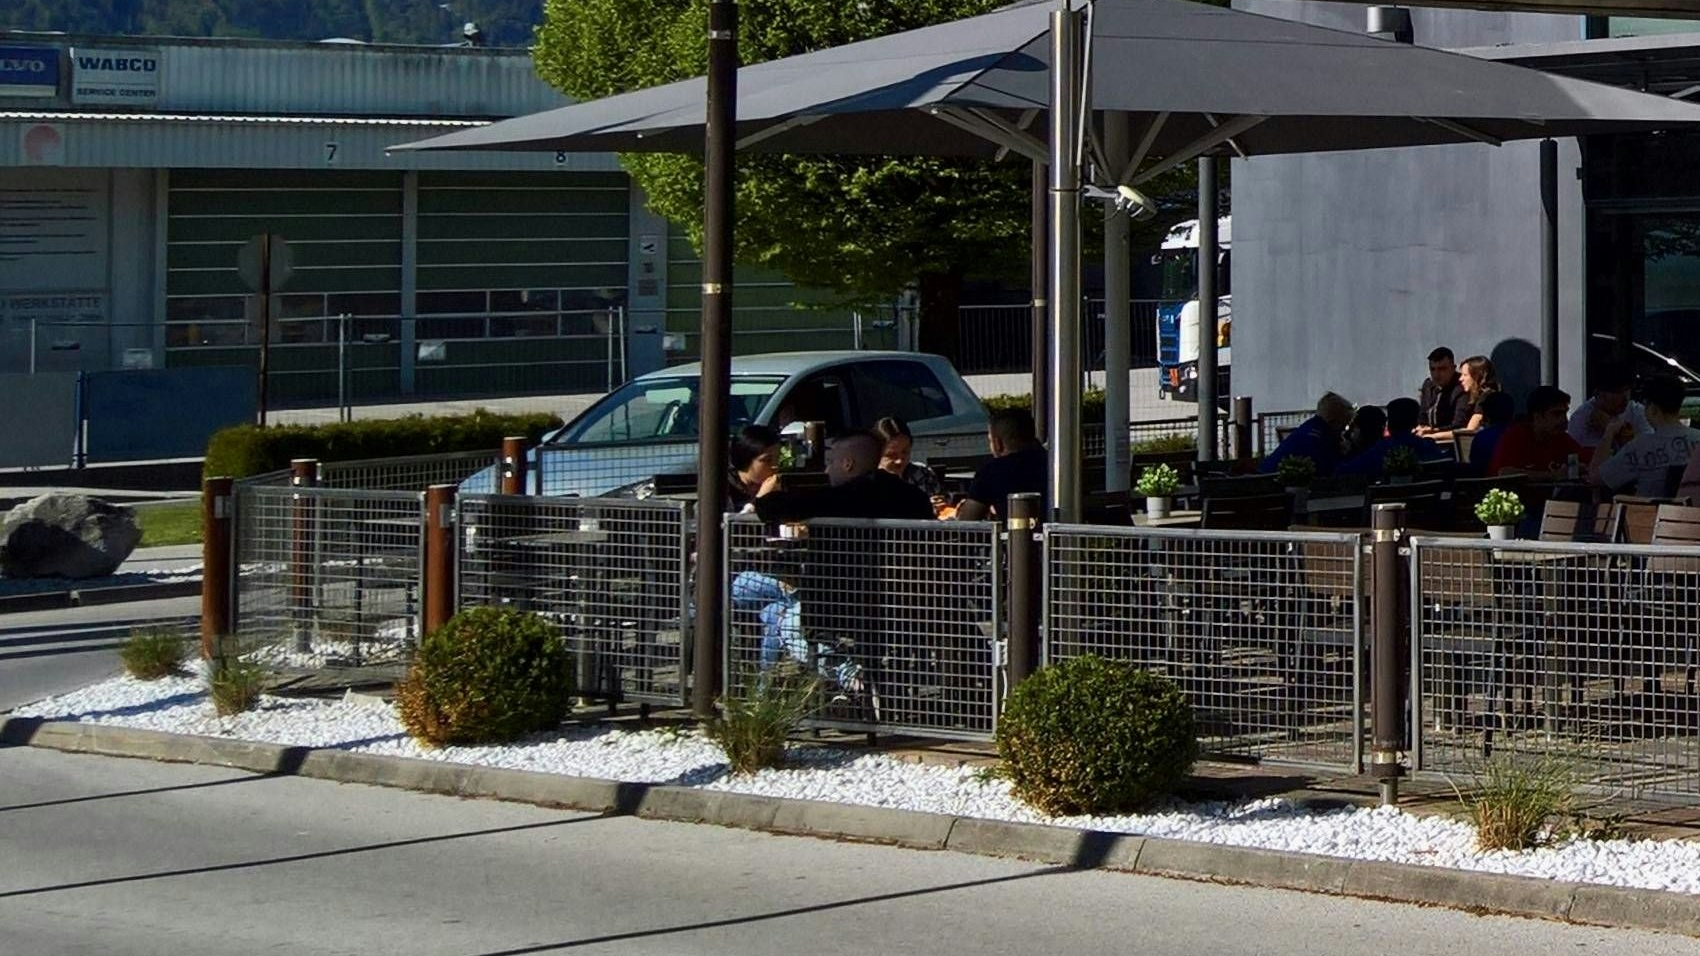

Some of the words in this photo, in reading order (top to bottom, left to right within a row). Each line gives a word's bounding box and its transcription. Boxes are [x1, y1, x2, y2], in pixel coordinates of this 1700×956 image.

[79, 57, 156, 72] WABCO
[77, 88, 115, 97] SERVICE
[119, 89, 156, 97] CENTER
[326, 144, 337, 161] 7
[556, 150, 566, 163] 8
